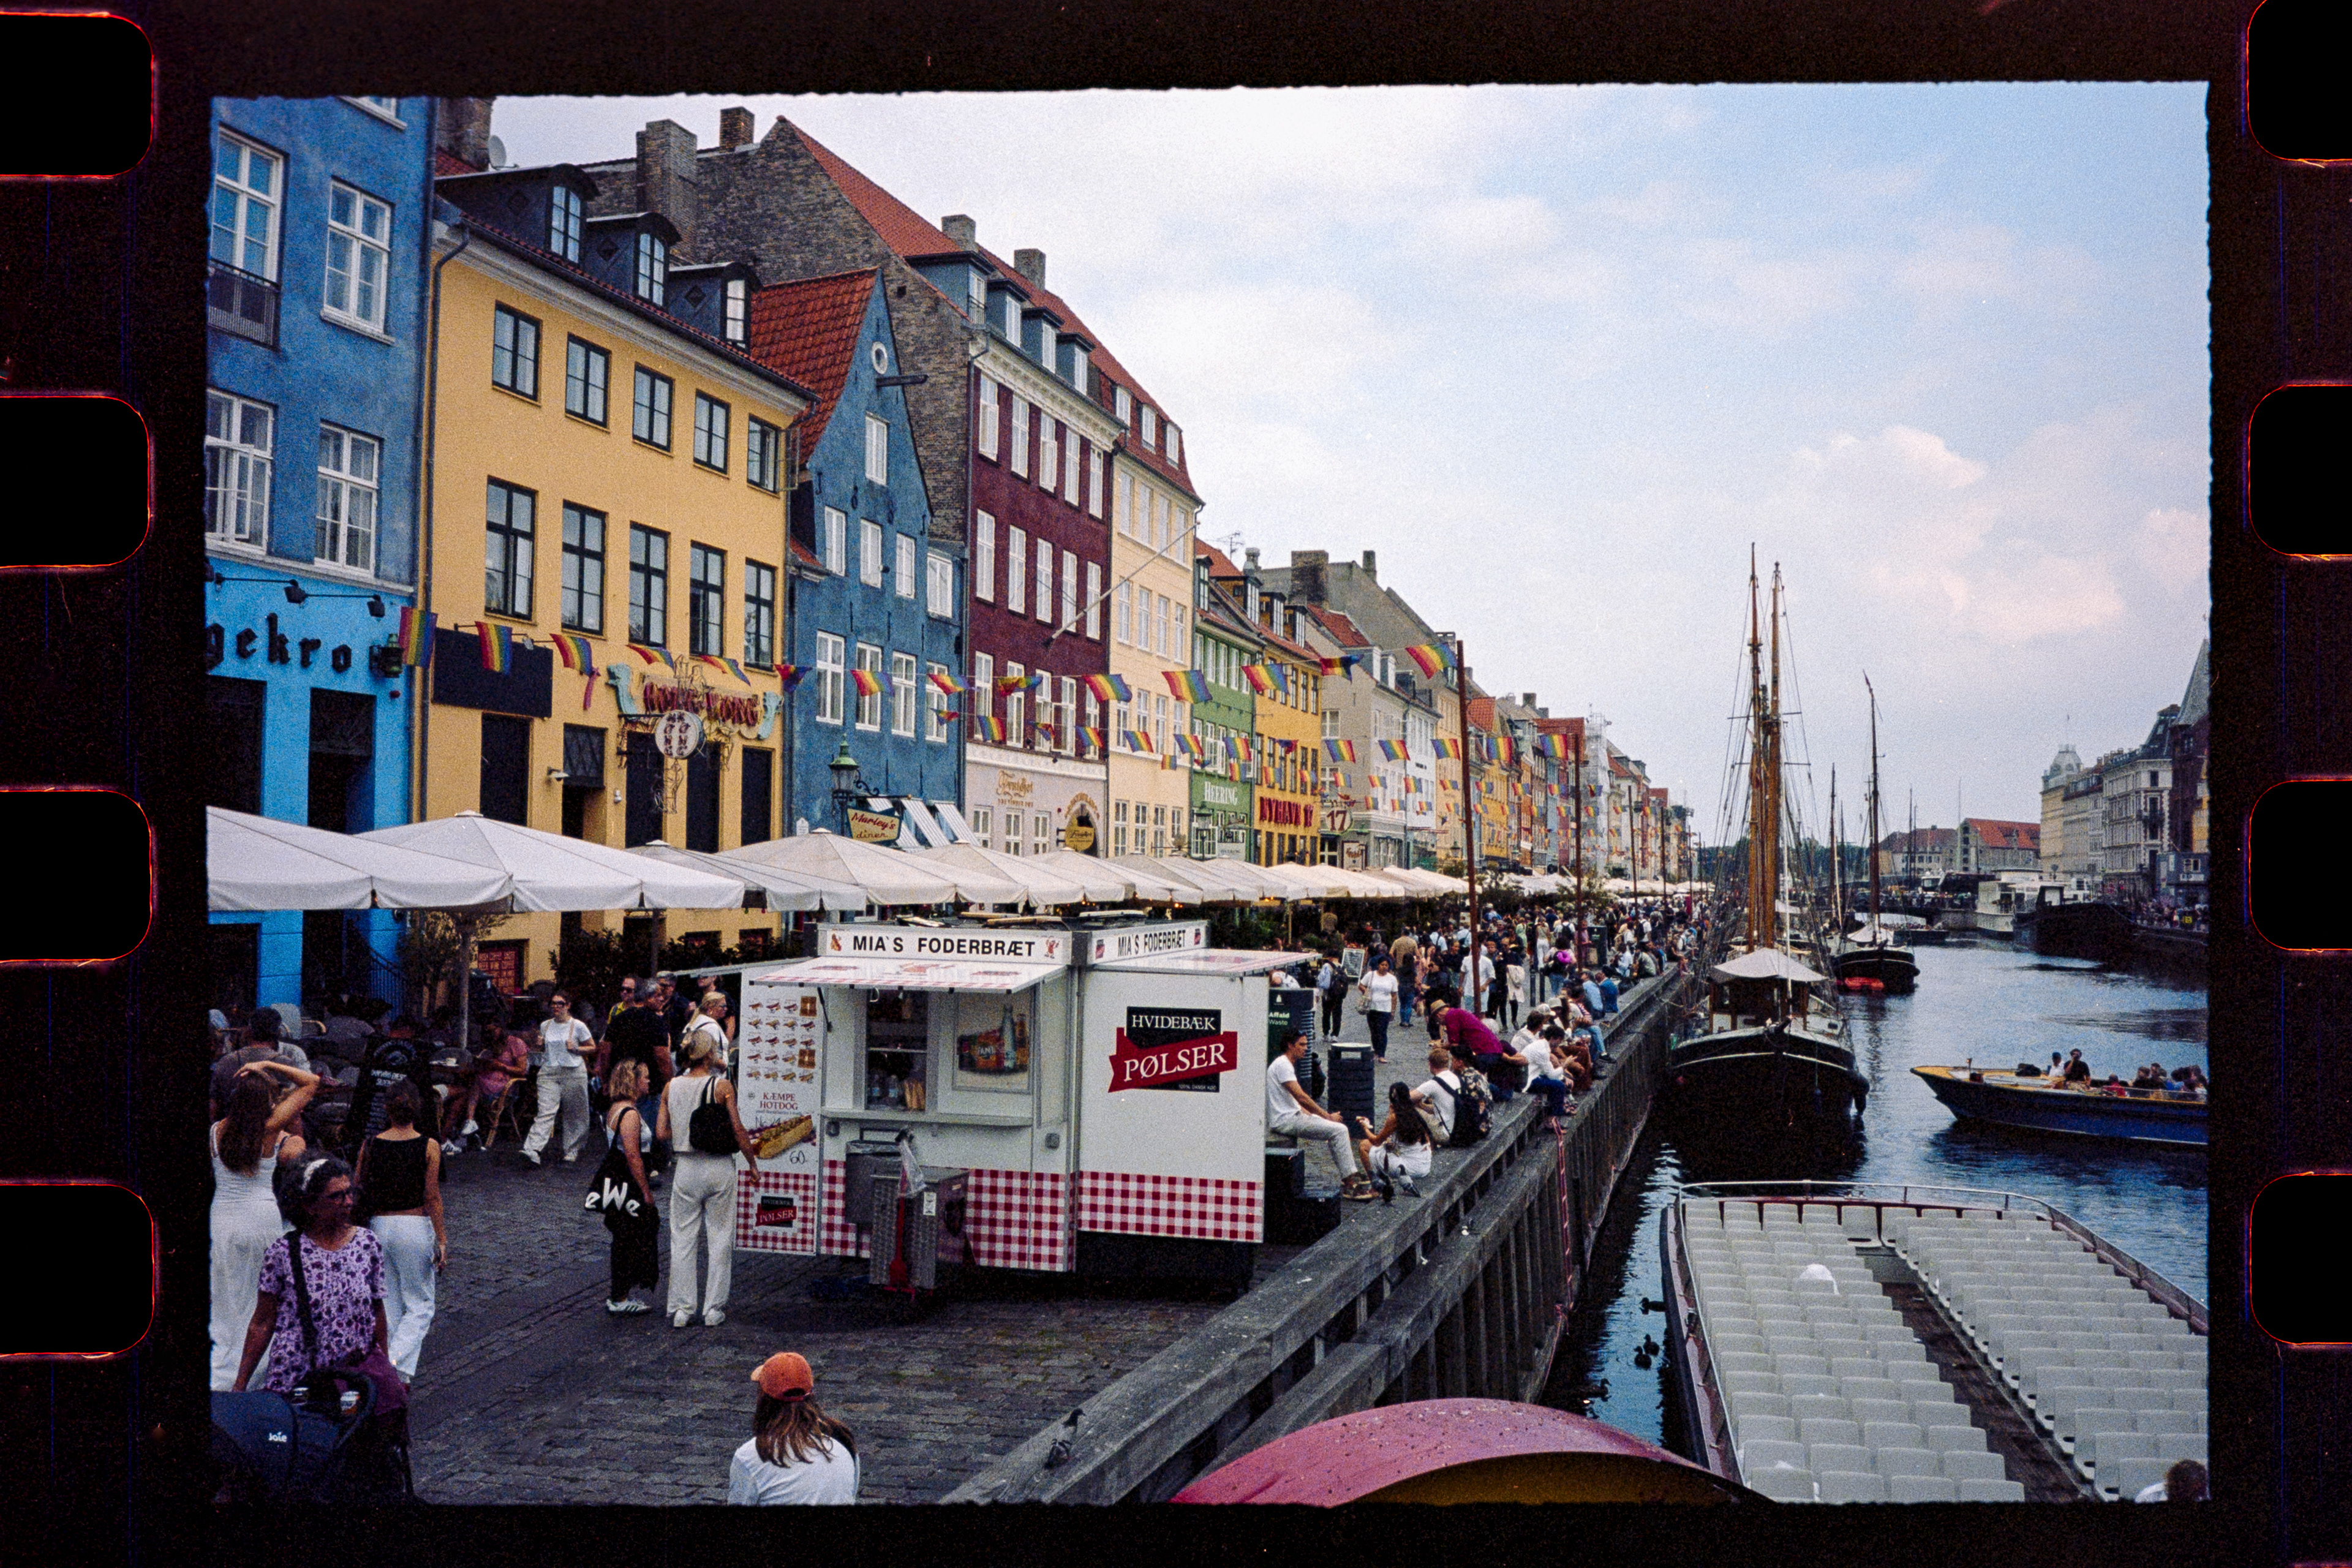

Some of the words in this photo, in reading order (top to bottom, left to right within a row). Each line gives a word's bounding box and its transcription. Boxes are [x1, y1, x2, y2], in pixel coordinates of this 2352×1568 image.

[1204, 781, 1238, 805] HEERING
[851, 812, 896, 831] Marley's
[1326, 810, 1347, 831] 17
[856, 830, 887, 839] diner
[918, 938, 1035, 957] FODERBRÆT
[1144, 929, 1186, 953] FODERBRÆT
[1132, 1015, 1216, 1030] HVIDEBÆK
[1124, 1043, 1227, 1082] PØLSER
[760, 1101, 798, 1110] HOTDOG
[763, 1092, 795, 1101] KÆMPE
[585, 1177, 640, 1217] eWe
[268, 1431, 287, 1442] Joie
